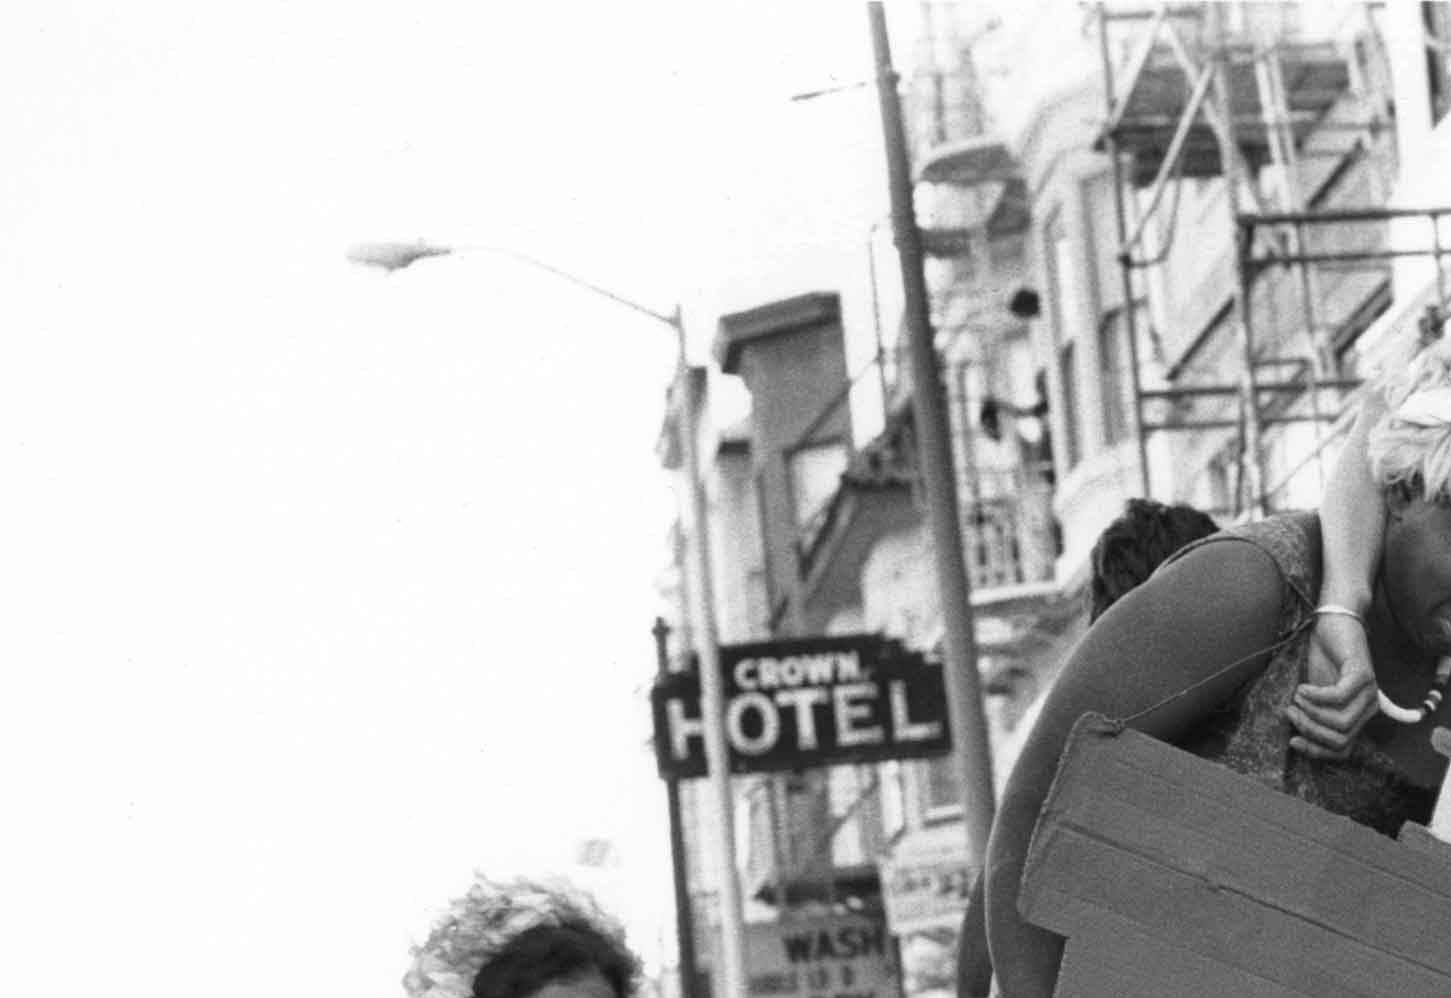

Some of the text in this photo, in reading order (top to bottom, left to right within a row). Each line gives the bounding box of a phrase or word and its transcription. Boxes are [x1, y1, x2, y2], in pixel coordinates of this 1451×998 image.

[733, 651, 861, 691] CROWN
[665, 679, 943, 760] HOTEL
[783, 924, 886, 964] WASH
